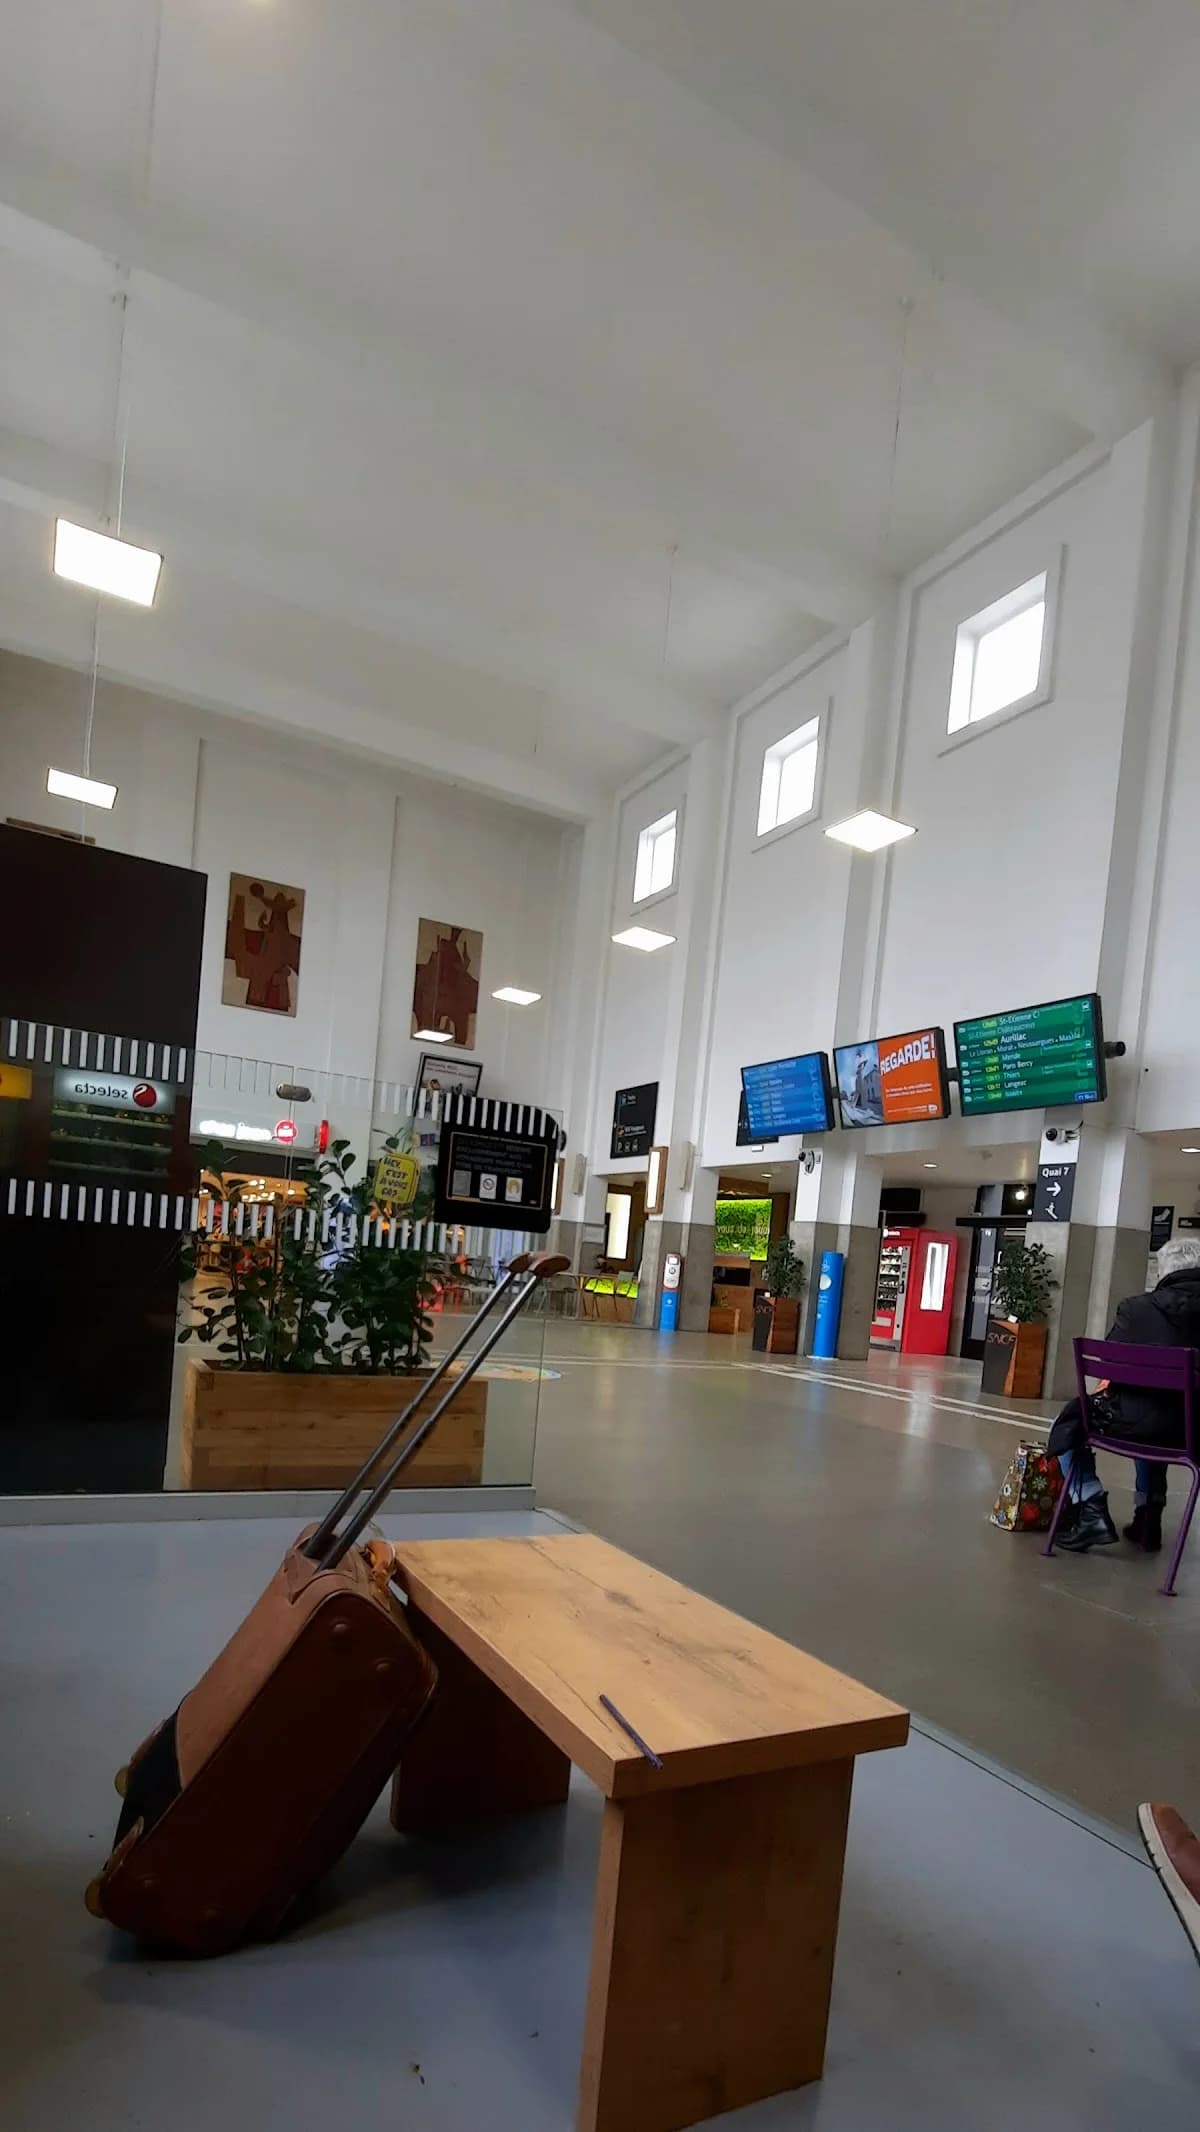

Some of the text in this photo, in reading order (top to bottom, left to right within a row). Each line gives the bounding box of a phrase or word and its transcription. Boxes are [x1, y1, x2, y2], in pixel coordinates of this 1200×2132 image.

[1000, 1032, 1027, 1043] Aurillac
[1042, 1166, 1070, 1178] Quai 7
